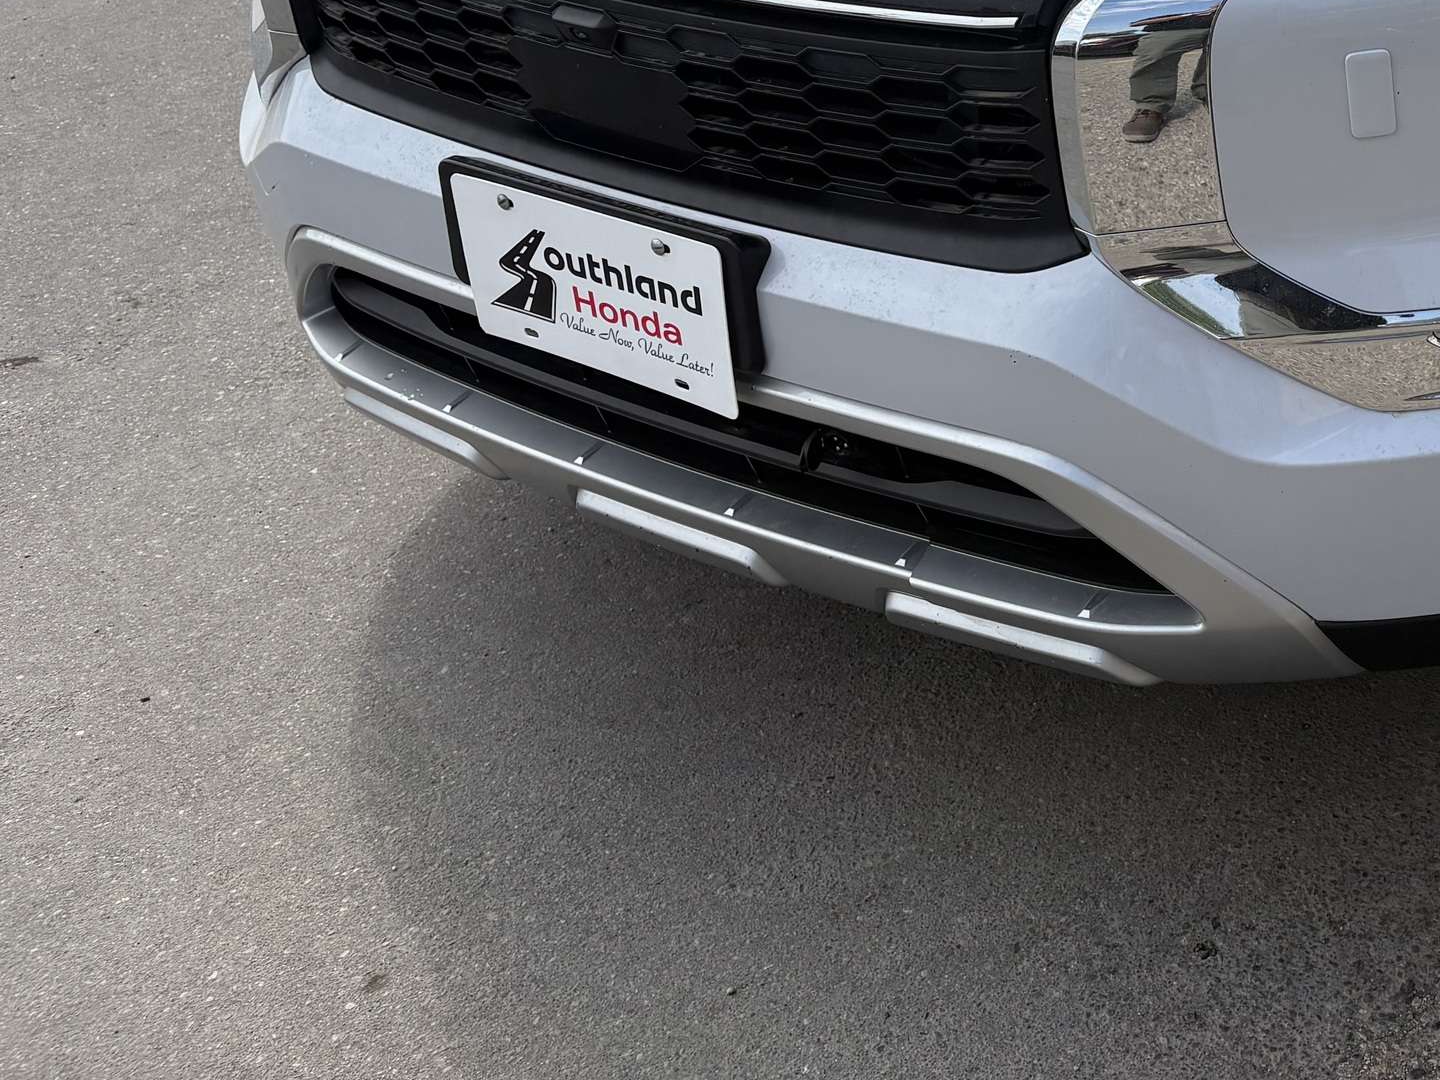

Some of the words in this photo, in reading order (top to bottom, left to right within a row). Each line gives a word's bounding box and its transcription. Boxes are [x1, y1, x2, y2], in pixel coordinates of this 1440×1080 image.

[559, 312, 597, 337] Value
[599, 328, 635, 352] Now,
[637, 337, 675, 363] Value
[676, 352, 715, 377] Later!
[571, 285, 683, 346] Honda
